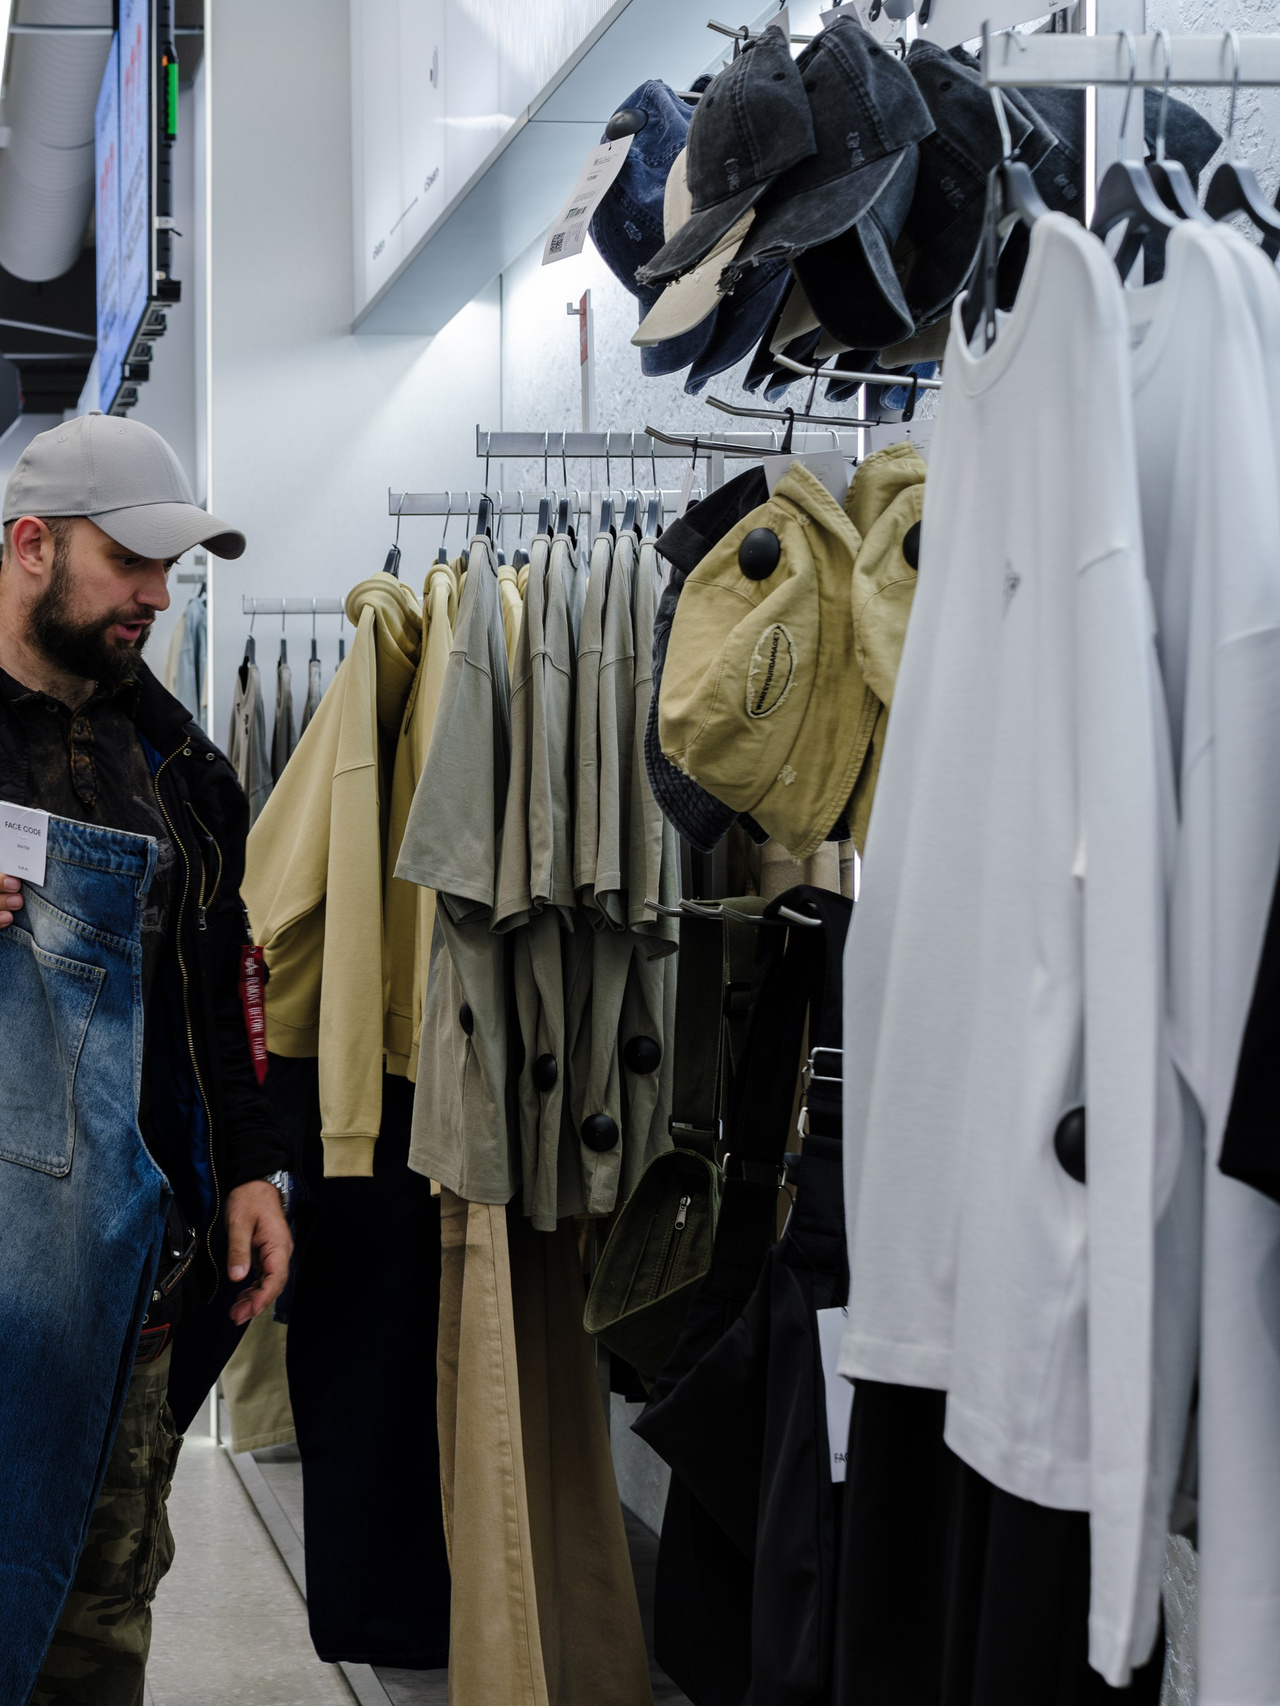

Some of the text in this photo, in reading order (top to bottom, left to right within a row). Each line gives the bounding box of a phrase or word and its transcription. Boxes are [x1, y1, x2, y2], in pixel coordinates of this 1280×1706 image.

[4, 821, 42, 836] FACE CODE
[246, 976, 267, 1061] REMOVE BEFORE FLIGHT
